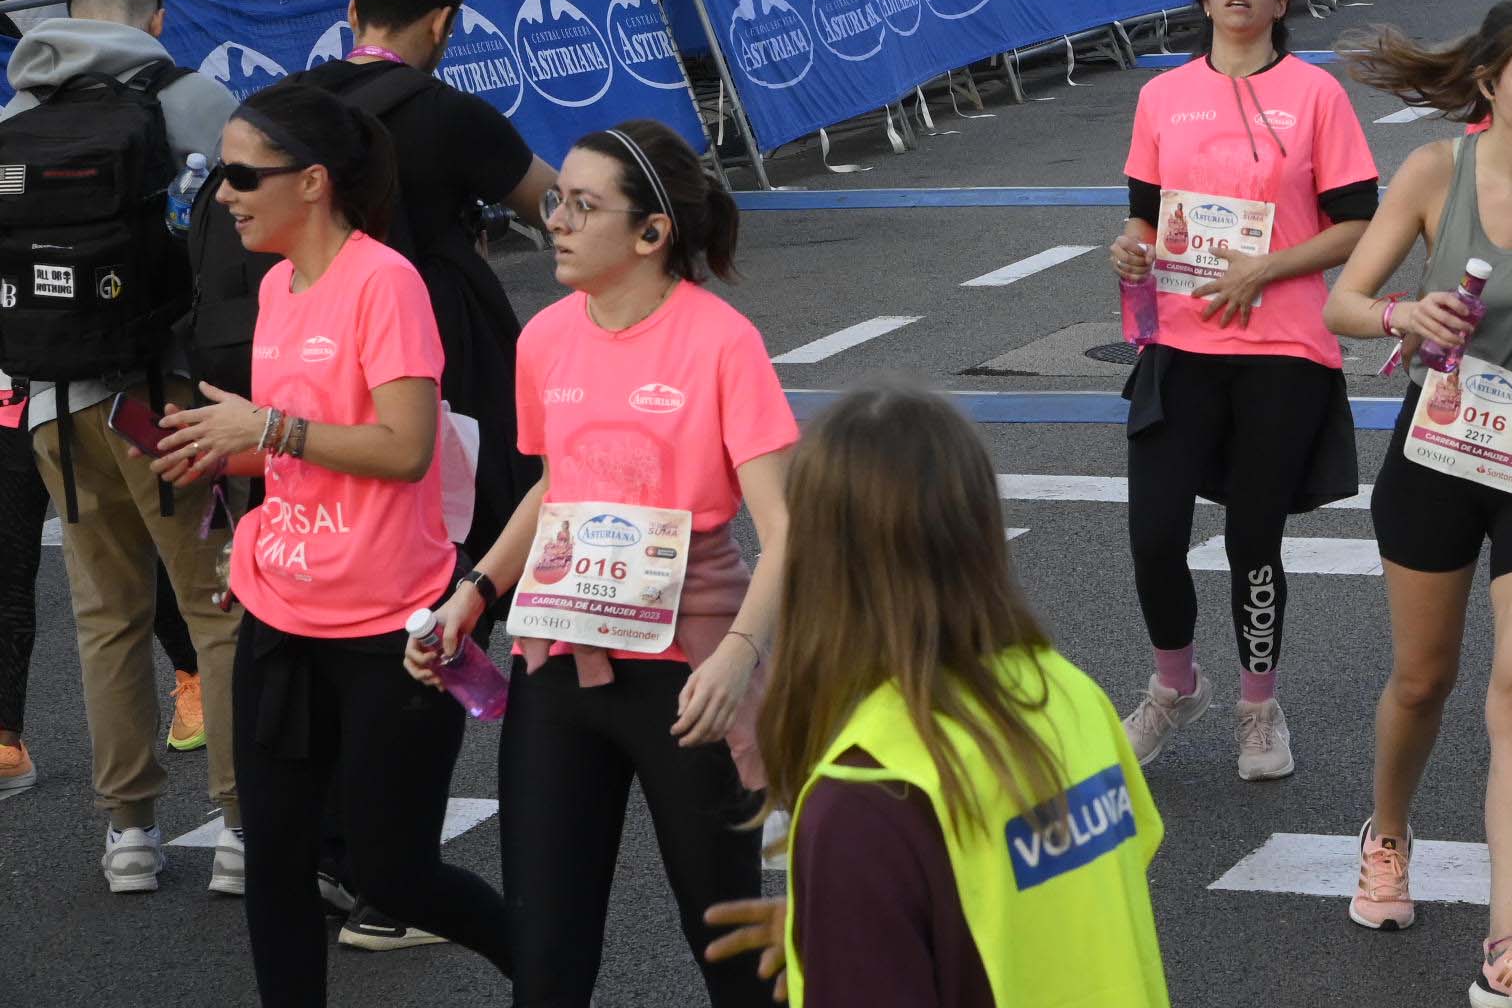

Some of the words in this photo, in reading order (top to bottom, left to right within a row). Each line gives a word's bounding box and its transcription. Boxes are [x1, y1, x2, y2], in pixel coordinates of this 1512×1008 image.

[531, 30, 561, 43] CENTRAL
[561, 25, 592, 39] LECHERA
[472, 40, 504, 54] LECHERA
[522, 36, 609, 82] ASTURIANA
[1191, 234, 1229, 250] 016
[1166, 263, 1194, 273] CARRERA
[1195, 267, 1203, 275] DE
[1195, 254, 1219, 266] 8125
[52, 270, 63, 281] OR
[1161, 276, 1195, 288] OYSHO
[35, 282, 72, 294] NOTHING
[1463, 406, 1507, 432] 016
[1464, 428, 1493, 445] 2217
[1417, 447, 1455, 465] OYSHO
[1424, 432, 1460, 450] CARRERA
[1461, 444, 1472, 454] DE
[1472, 447, 1483, 457] LA
[1483, 449, 1510, 463] MUJER
[582, 526, 636, 543] ASTURIANA
[575, 557, 627, 580] 016
[575, 581, 617, 599] 18533
[531, 596, 574, 609] CARRERA
[575, 600, 588, 610] DE
[589, 602, 602, 612] LA
[604, 604, 636, 617] MUJER
[639, 610, 661, 620] 2023
[523, 615, 571, 630] OYSHO
[609, 626, 660, 641] Santander
[1243, 564, 1276, 675] adidas
